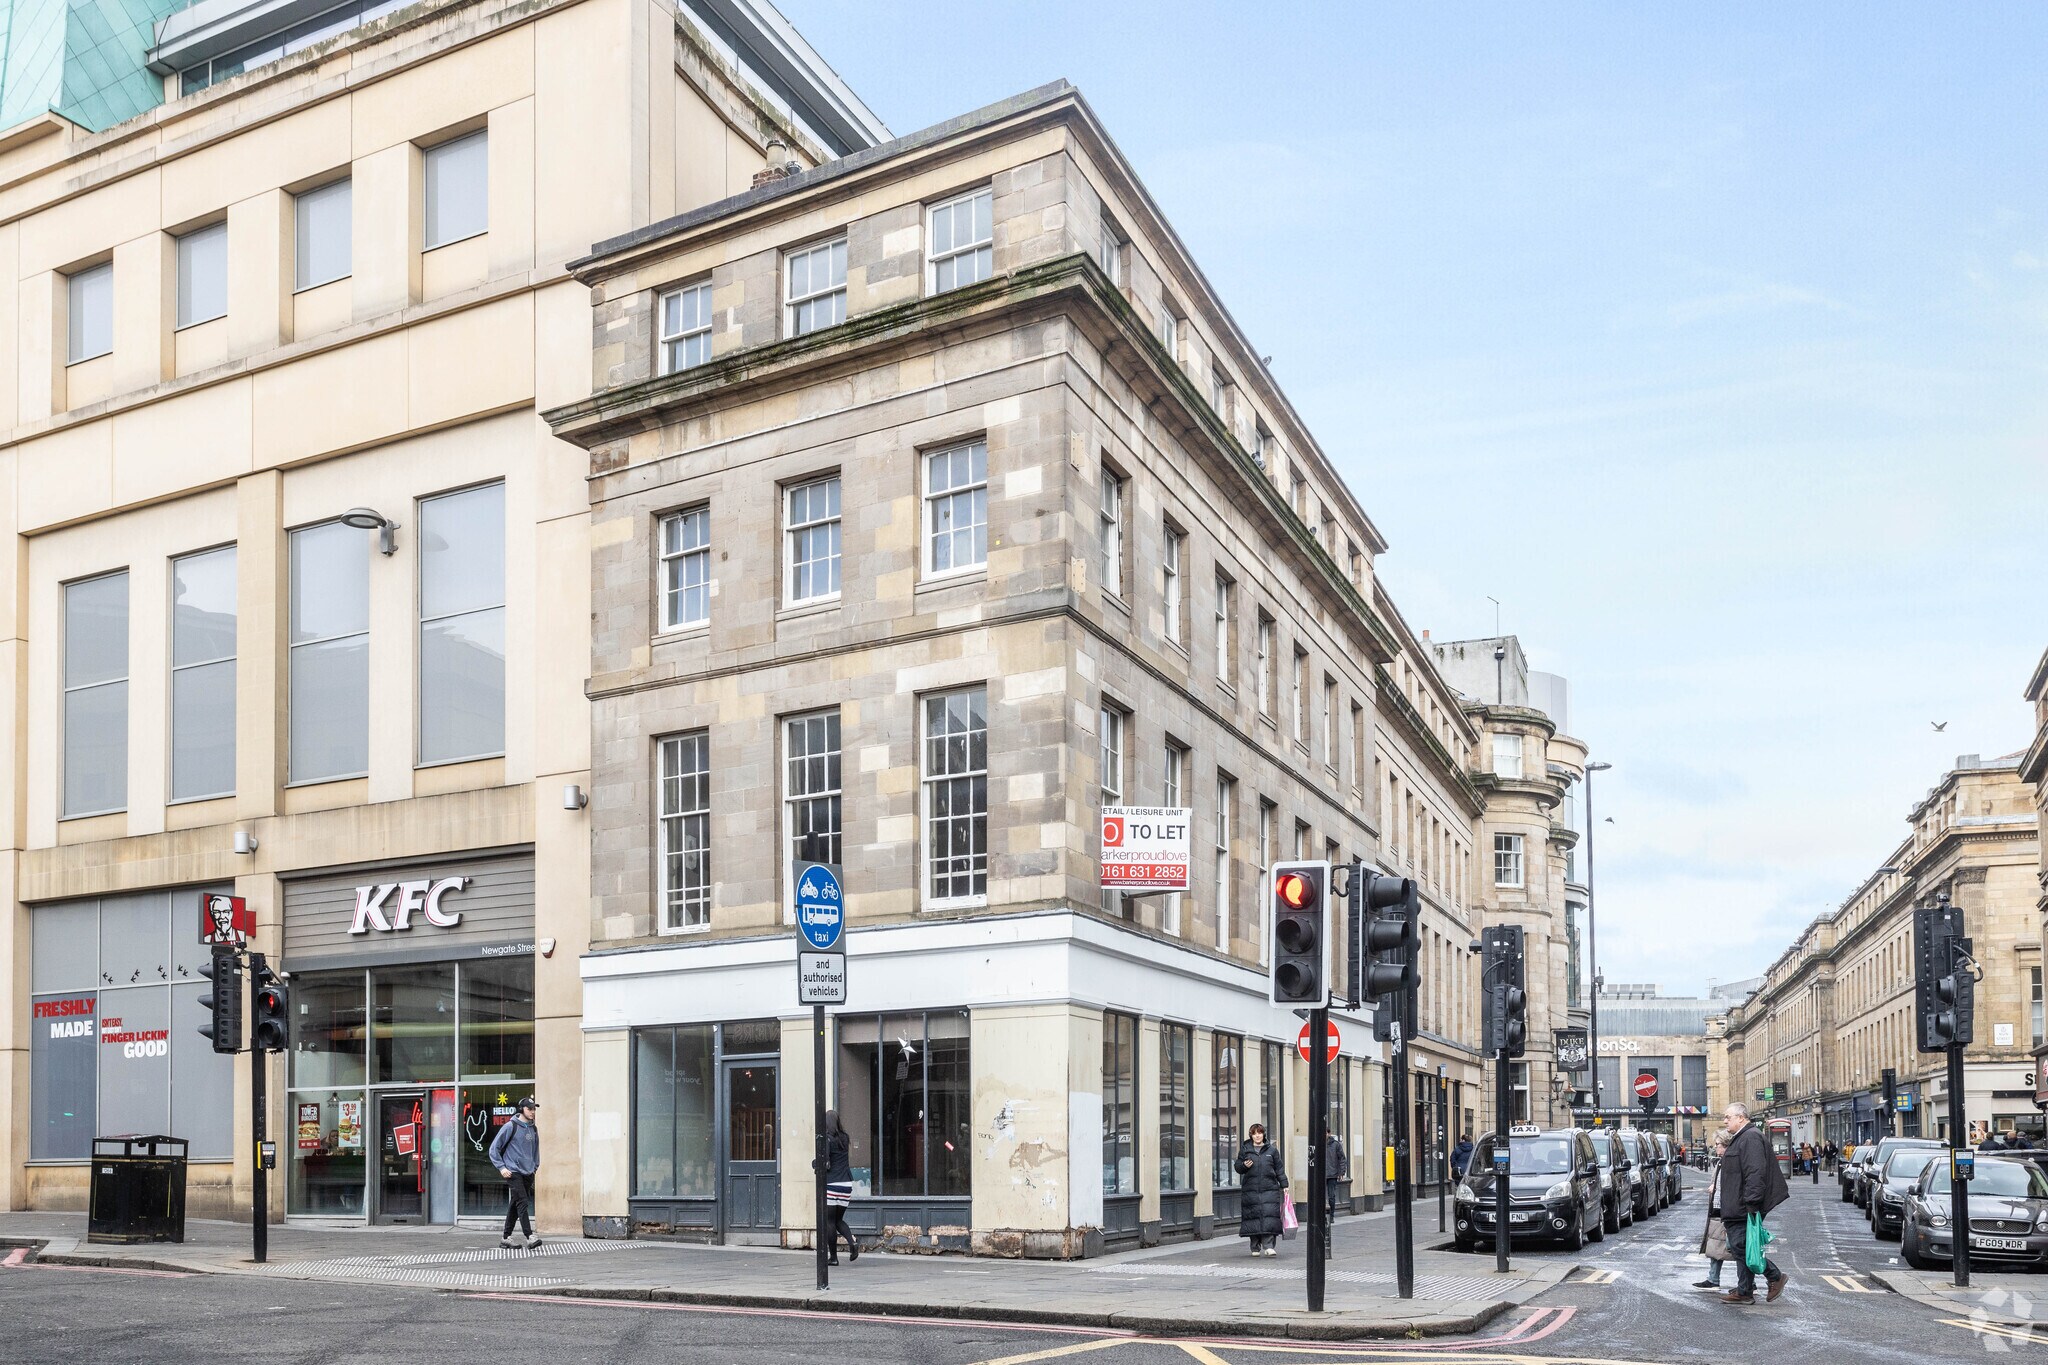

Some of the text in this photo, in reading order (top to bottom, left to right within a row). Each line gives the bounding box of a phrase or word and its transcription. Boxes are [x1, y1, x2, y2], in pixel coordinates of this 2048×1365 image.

[1130, 808, 1164, 816] LEISURE
[1130, 824, 1185, 839] TO LET
[1101, 849, 1187, 862] arkerproudlove
[1129, 866, 1150, 877] 631
[1154, 866, 1184, 878] 2852
[347, 876, 466, 934] KFC
[814, 931, 829, 942] taxi
[481, 945, 516, 956] Newgate
[517, 943, 536, 953] Stree
[816, 959, 829, 969] and
[803, 972, 843, 983] authorised
[808, 986, 839, 996] vehicles
[34, 998, 97, 1019] FRESHLY
[50, 1020, 94, 1039] MADE
[101, 1029, 169, 1043] FINGER LICKIN'
[1559, 1037, 1585, 1046] DUKE
[124, 1040, 167, 1059] GOOD
[2024, 1073, 2036, 1086] S
[300, 1106, 318, 1116] TOWER
[493, 1106, 517, 1115] HELLO
[1979, 1239, 2023, 1248] FG09 WDR
